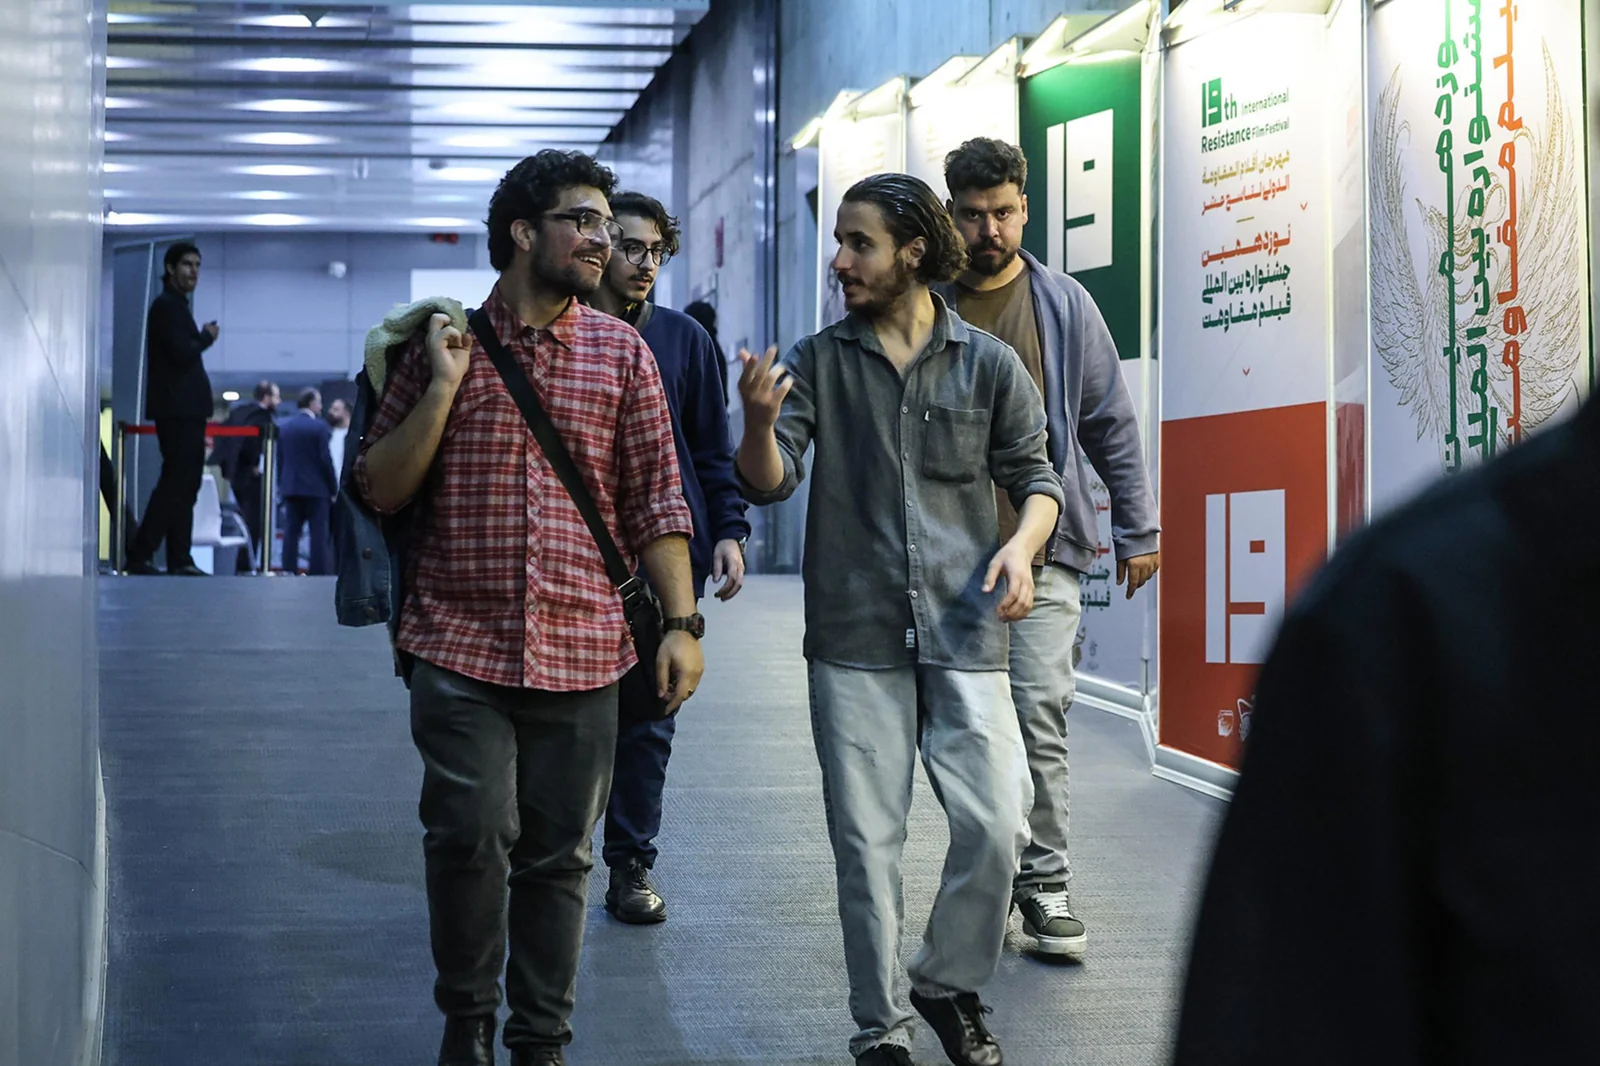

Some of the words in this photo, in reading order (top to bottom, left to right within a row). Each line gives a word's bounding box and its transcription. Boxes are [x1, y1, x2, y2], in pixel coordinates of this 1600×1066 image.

[1241, 86, 1289, 116] International
[1462, 0, 1492, 218] شنواره
[1201, 127, 1251, 154] Resistance
[1265, 115, 1289, 134] Festival
[1435, 0, 1462, 473] وزدهمین
[1246, 260, 1291, 295] جشنواره
[1202, 301, 1258, 334] مقاومت
[1258, 286, 1291, 328] فیلم
